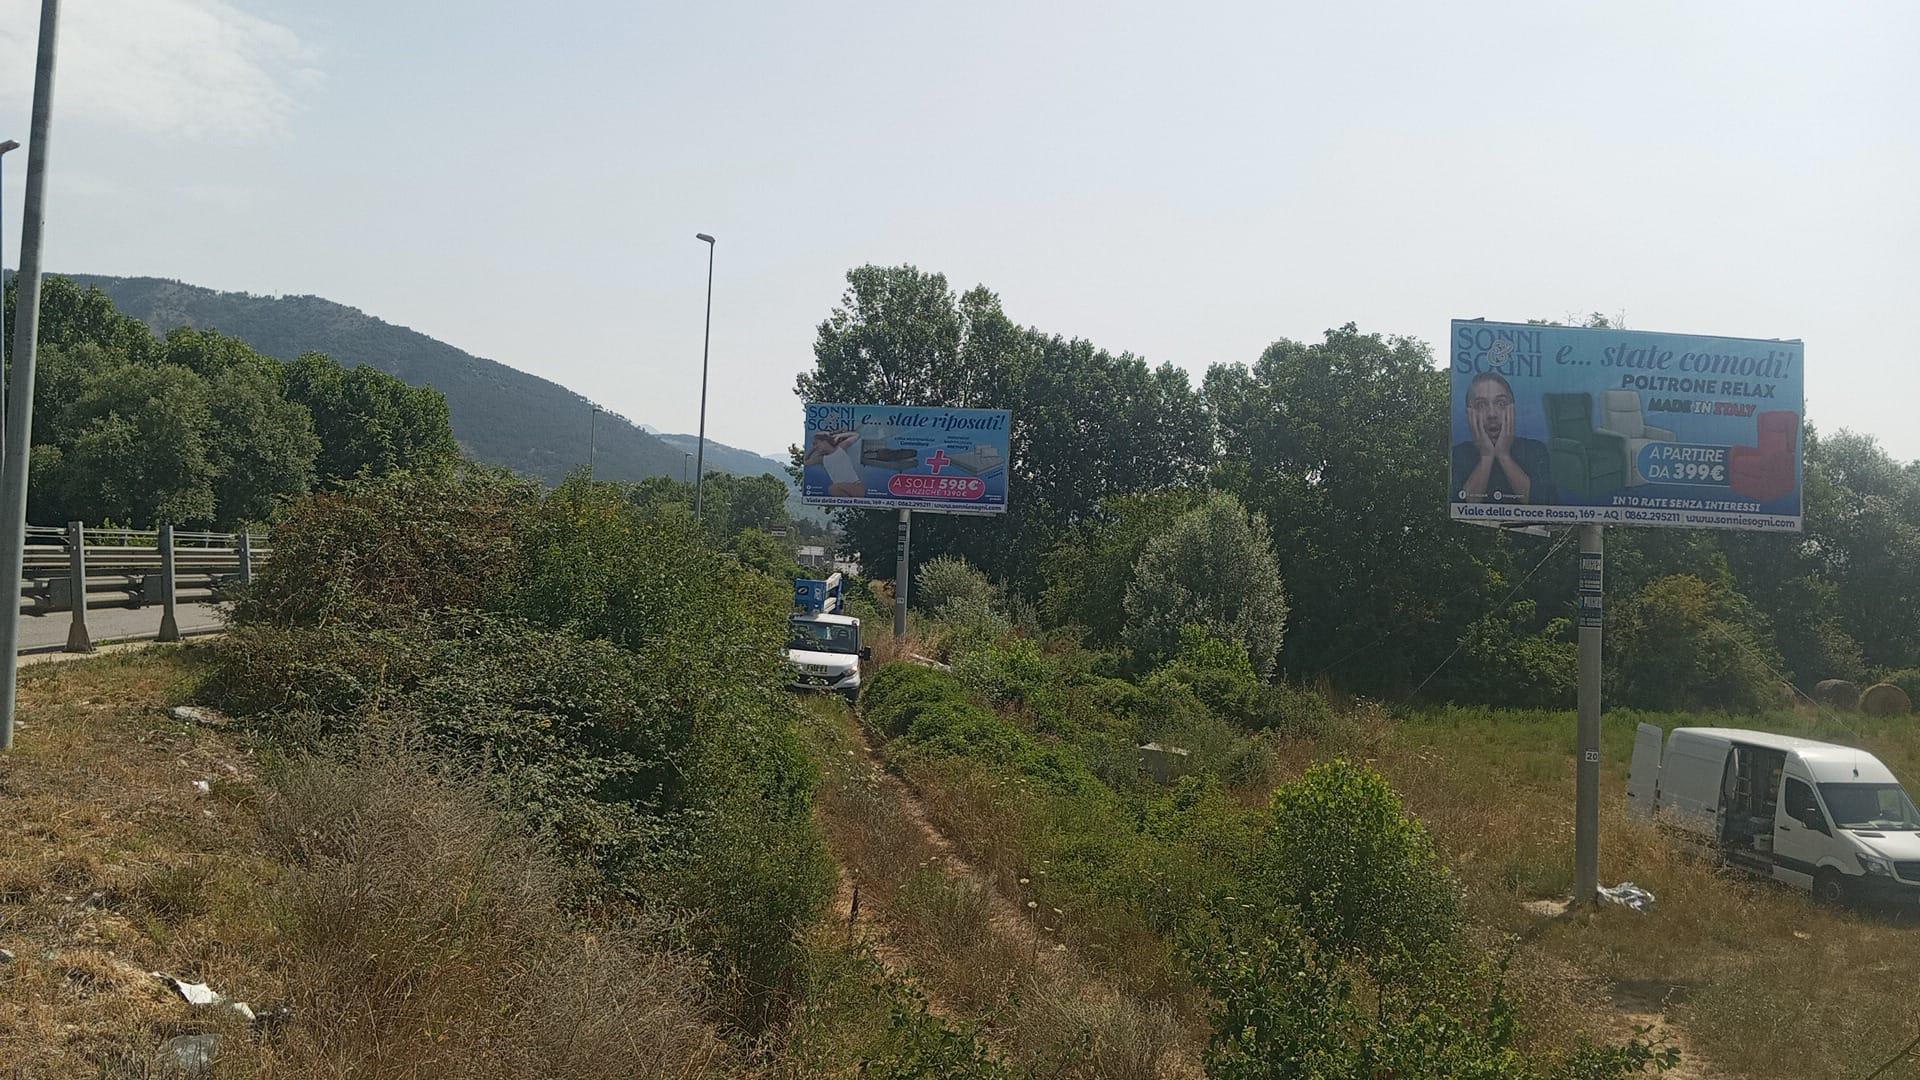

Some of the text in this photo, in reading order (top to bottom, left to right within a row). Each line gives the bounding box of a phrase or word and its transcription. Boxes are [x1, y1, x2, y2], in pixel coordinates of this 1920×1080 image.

[1457, 327, 1542, 354] SONNI
[1456, 351, 1542, 377] SOGNI
[1601, 343, 1673, 369] state
[1680, 350, 1793, 378] comodi!
[1622, 374, 1777, 399] POLTRONE RELAX
[809, 406, 855, 419] SONNI
[1694, 401, 1712, 415] IN
[886, 411, 928, 427] state
[932, 412, 1005, 431] riposati!
[1649, 447, 1724, 463] A PARTIRE
[1649, 463, 1724, 482] DA 399€
[893, 478, 979, 491] A SOLI 598€
[1613, 496, 1761, 512] IN 10 RATE SENZA INTERESSI
[1457, 505, 1484, 516] Viale
[1485, 506, 1512, 517] della
[1513, 508, 1544, 518] Croce
[1545, 509, 1578, 520] Rossa,
[1580, 509, 1595, 518] 169
[1603, 512, 1619, 520] AQ
[1625, 511, 1680, 522] 0862.295211
[1686, 515, 1796, 528] www.sonniesogni.com
[1587, 752, 1598, 760] 20
